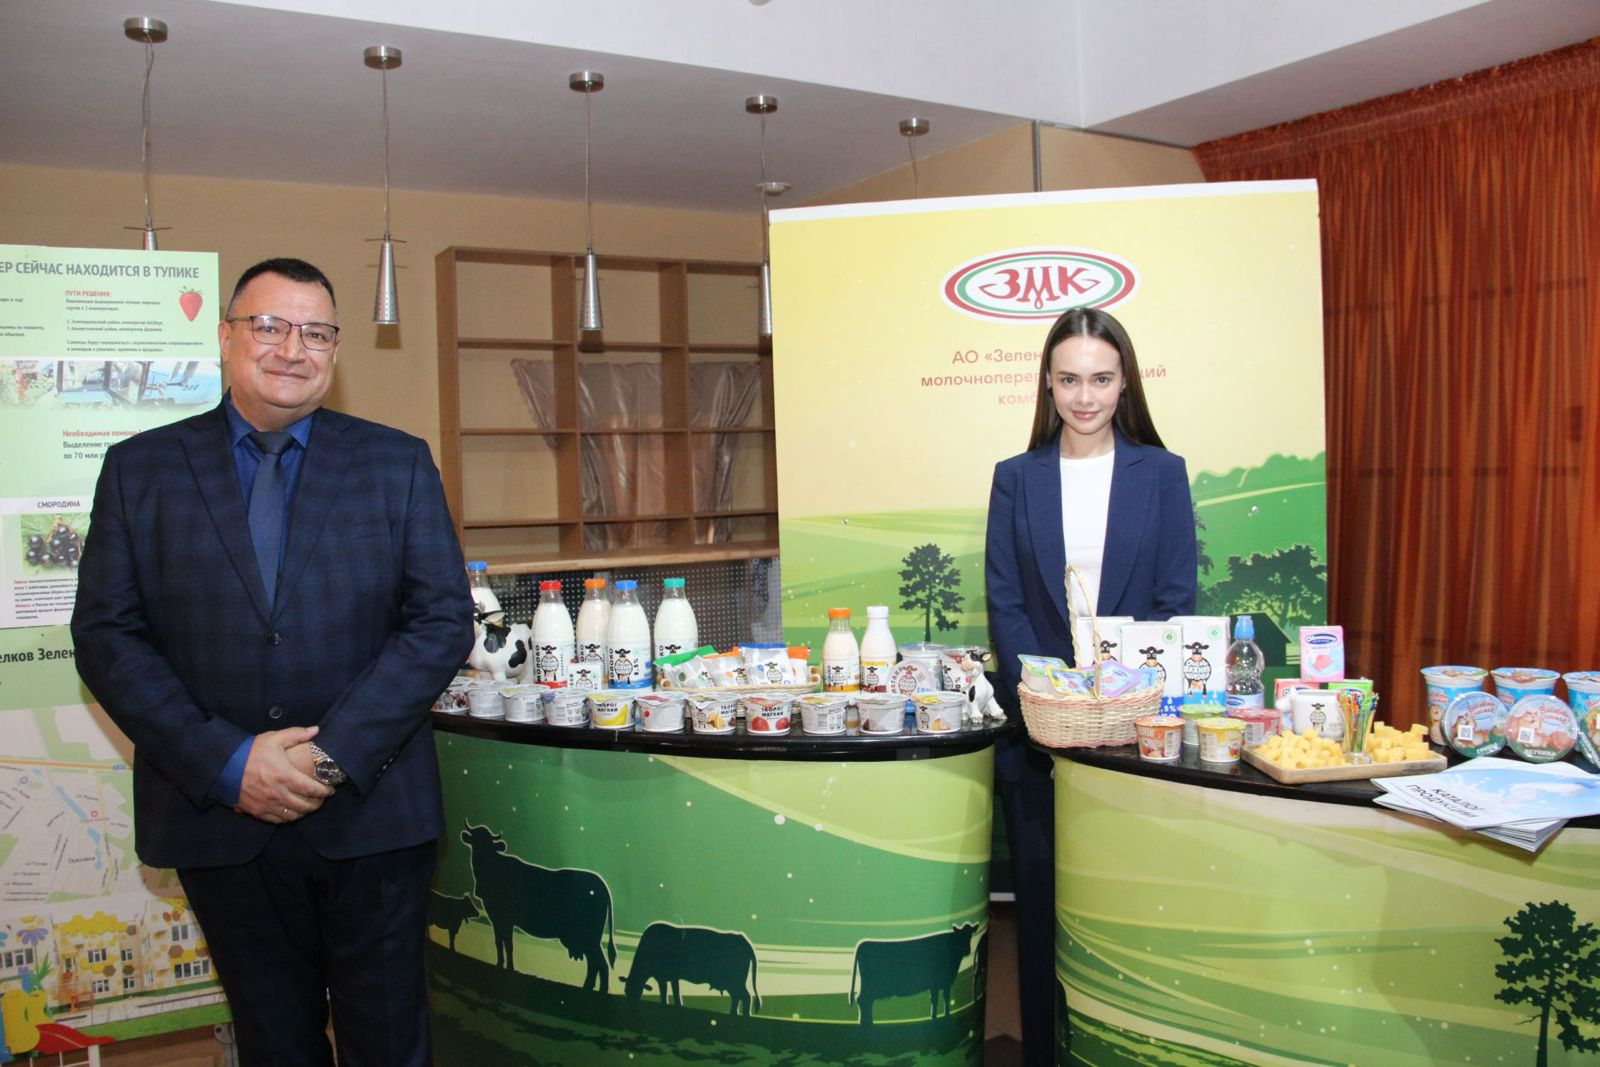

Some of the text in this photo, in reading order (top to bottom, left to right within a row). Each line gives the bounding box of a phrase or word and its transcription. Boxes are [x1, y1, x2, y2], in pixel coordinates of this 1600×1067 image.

[15, 259, 64, 276] СЕЙЧАС
[66, 263, 140, 278] НАХОДИТСЯ
[143, 265, 151, 277] В
[153, 266, 200, 279] ТУПИКЕ
[978, 265, 1101, 311] ЗМК
[952, 350, 979, 364] АО
[63, 430, 110, 438] Необходимая
[63, 441, 103, 449] Выделение
[37, 500, 81, 509] СМОРОДИНА
[535, 644, 543, 682] МОЛОКО
[1431, 788, 1487, 812] КАТАЛОГ
